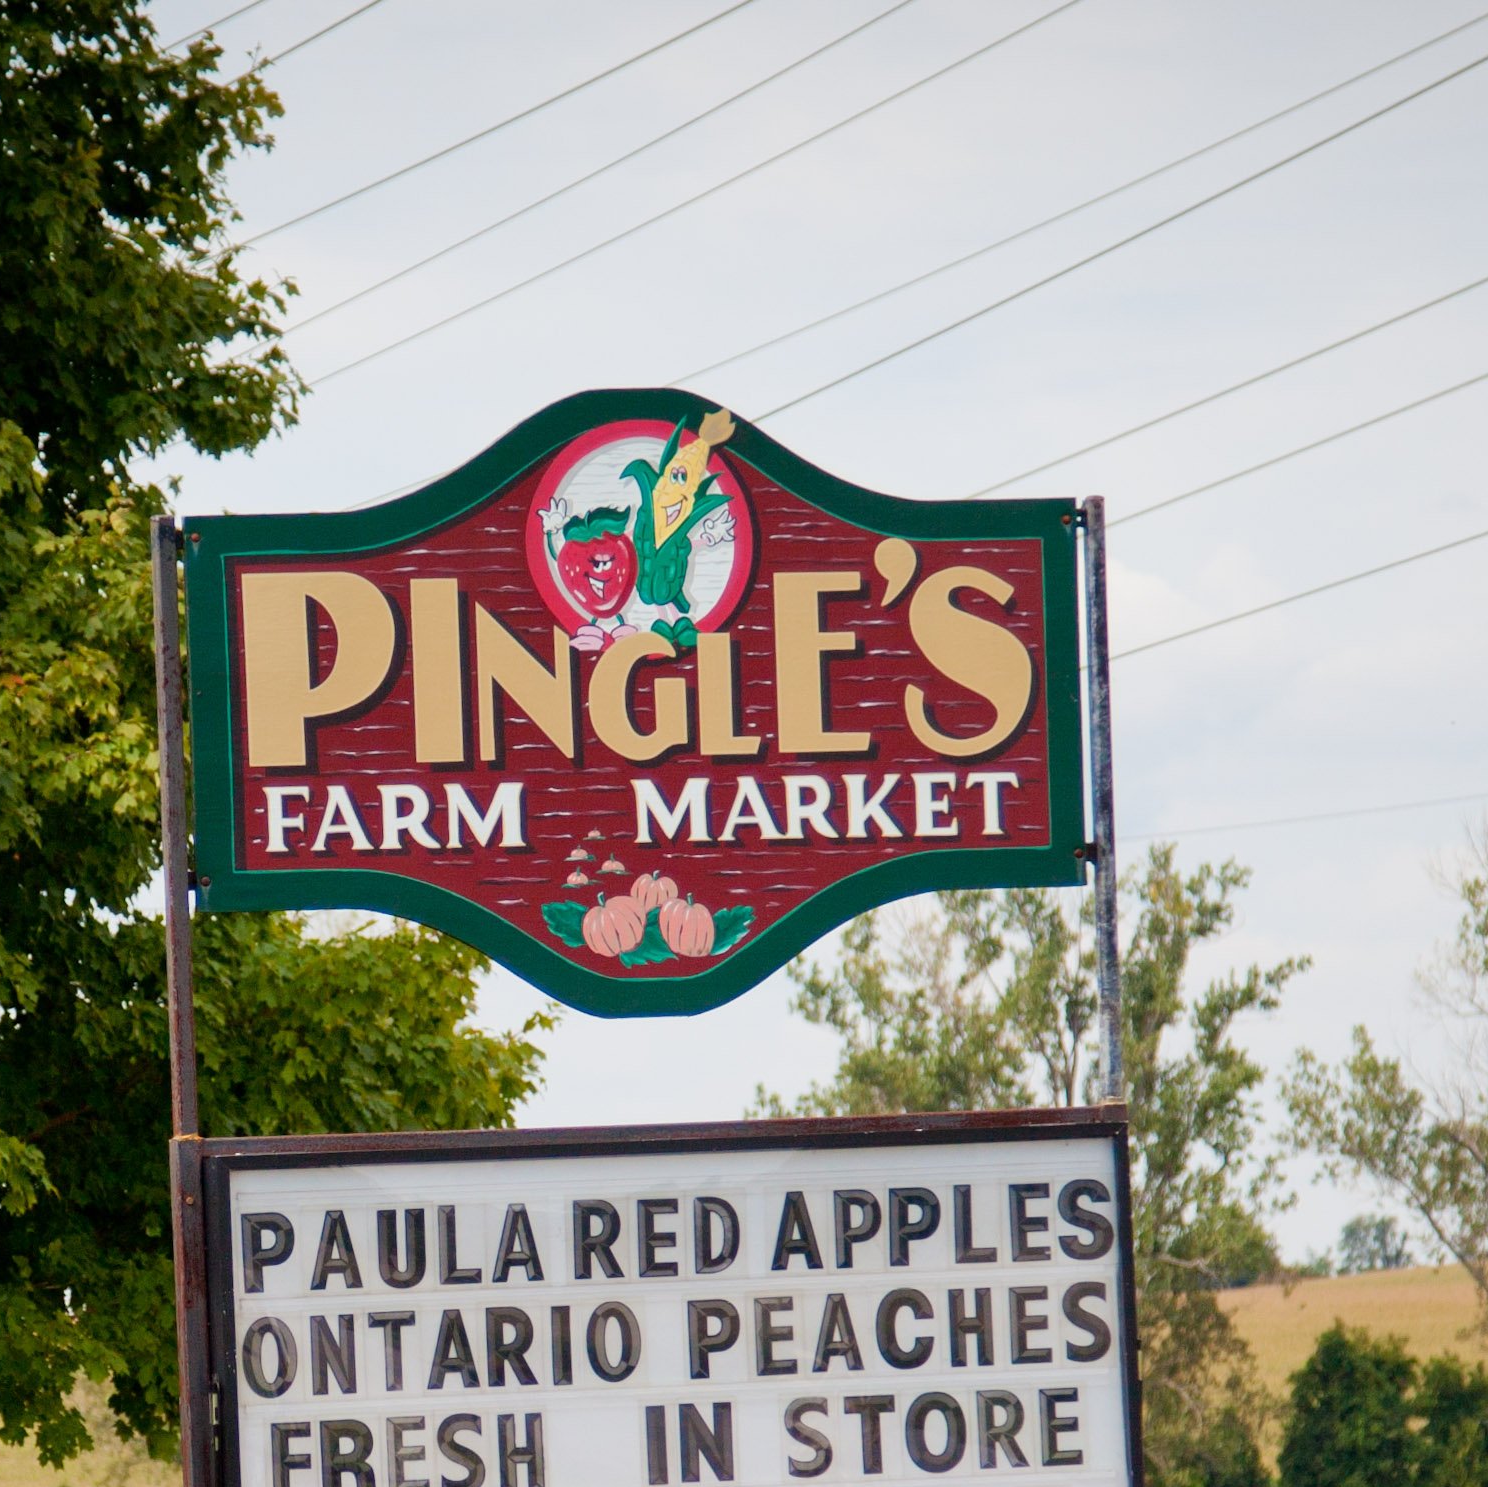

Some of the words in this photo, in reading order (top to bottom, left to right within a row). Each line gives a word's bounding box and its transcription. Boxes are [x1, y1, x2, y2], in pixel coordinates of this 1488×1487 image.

[241, 537, 1032, 767] PINGLE'S
[263, 783, 526, 854] FARM
[630, 772, 1019, 845] MARKET
[241, 1203, 544, 1294] PAULA
[573, 1195, 741, 1280] RED
[771, 1178, 1112, 1272] APPLES
[241, 1300, 642, 1399] ONTARIO
[687, 1281, 1112, 1380] PEACHES
[646, 1402, 734, 1486] IN
[784, 1386, 1083, 1479] STORE
